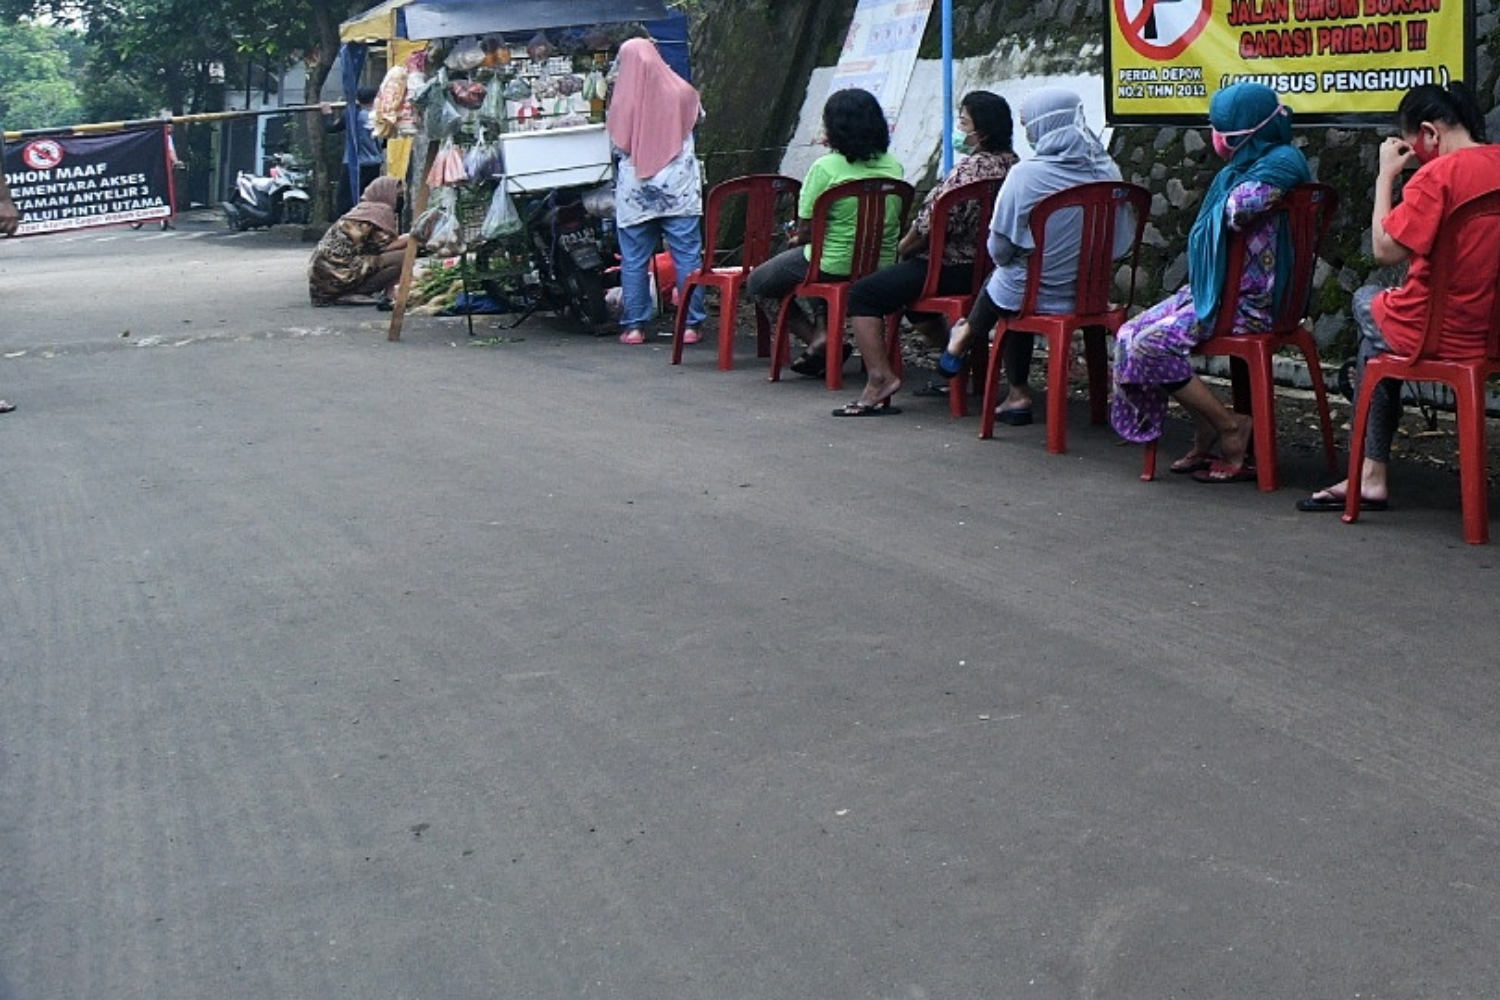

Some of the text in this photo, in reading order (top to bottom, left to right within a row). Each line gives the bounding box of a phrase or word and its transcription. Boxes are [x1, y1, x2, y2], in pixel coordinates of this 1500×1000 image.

[1240, 20, 1427, 59] GARASI PRIBADI !!!
[1119, 67, 1202, 81] PERDA DEPOK
[1323, 68, 1436, 92] PENGHUNI
[1118, 83, 1206, 98] NO.2 THN 2012
[4, 162, 107, 185] OHON MAAF
[11, 173, 146, 198] EMENTARA AKSES
[14, 186, 149, 210] TAMAN ANYELIR 3
[23, 209, 58, 222] ALUI
[62, 202, 108, 218] PINTU
[112, 196, 163, 211] UTAMA
